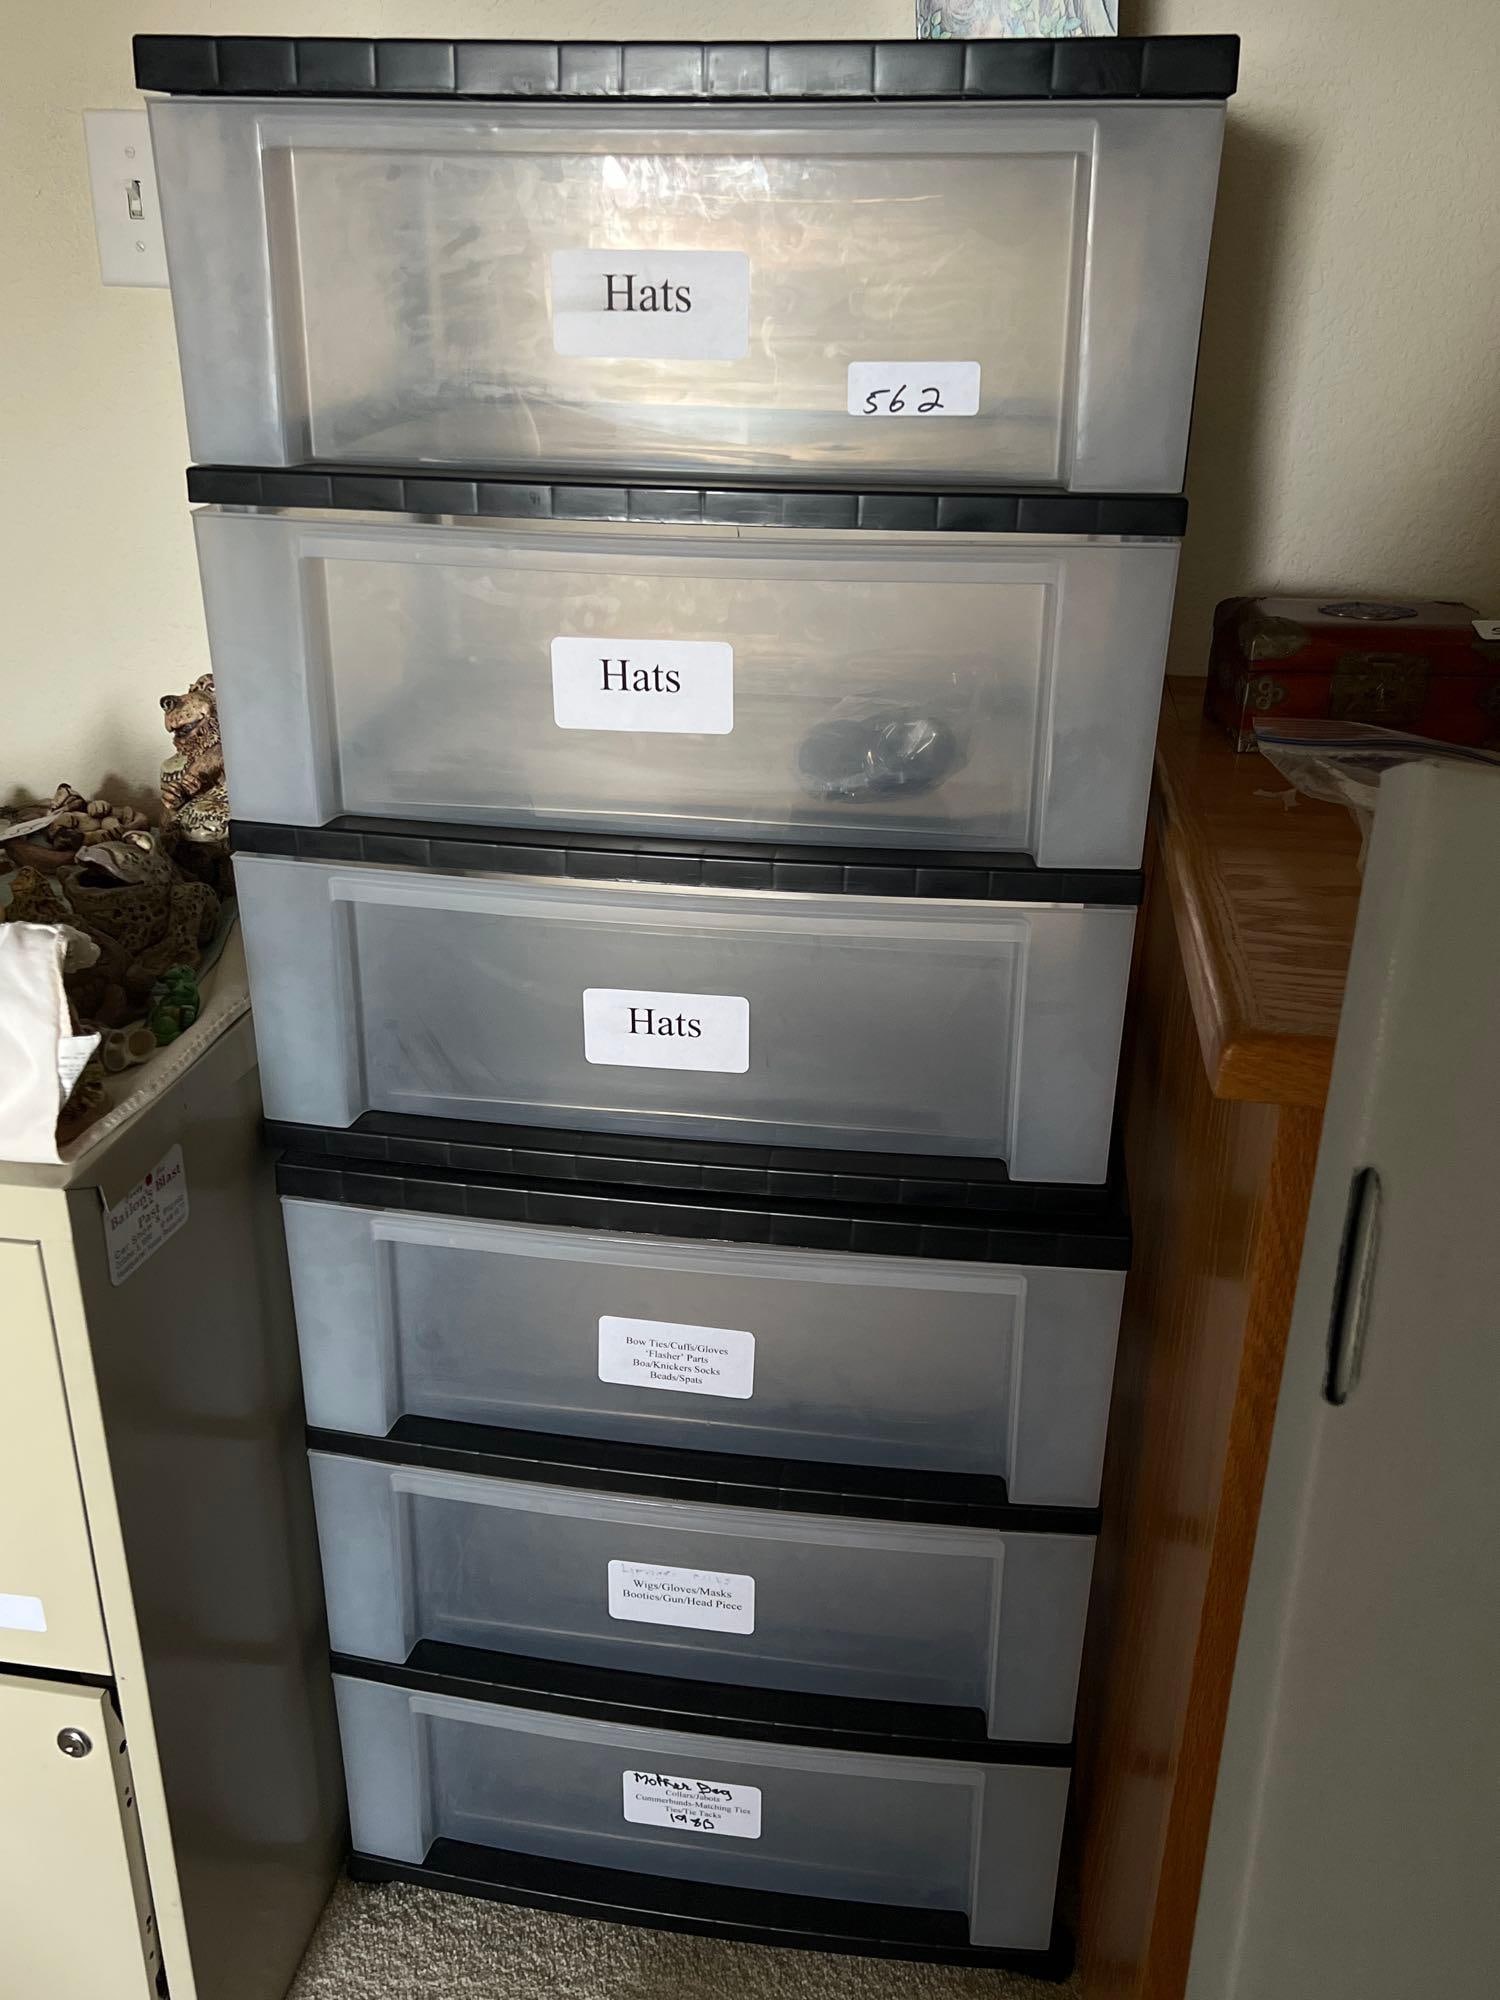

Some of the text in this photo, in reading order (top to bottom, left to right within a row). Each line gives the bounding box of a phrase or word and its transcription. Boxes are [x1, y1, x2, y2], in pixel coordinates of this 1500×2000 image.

[602, 273, 692, 312] Hats
[863, 385, 945, 415] 562
[599, 658, 682, 694] Hats
[627, 1007, 702, 1039] Hats
[155, 1164, 181, 1192] Blast
[626, 1336, 729, 1355] Bow Ties/Cuffs/Gloves
[633, 1358, 721, 1376] Boa/Knickers Socks
[687, 1354, 709, 1364] Parts
[650, 1371, 703, 1385] Beads/Spats
[633, 1579, 732, 1599] Wigs/Gloves/Masks
[623, 1589, 742, 1611] Booties/Gun/Head Piece
[633, 1772, 692, 1790] Mother
[700, 1811, 722, 1819] Tacks
[734, 1807, 751, 1815] Ties
[670, 1813, 715, 1830] 1980
